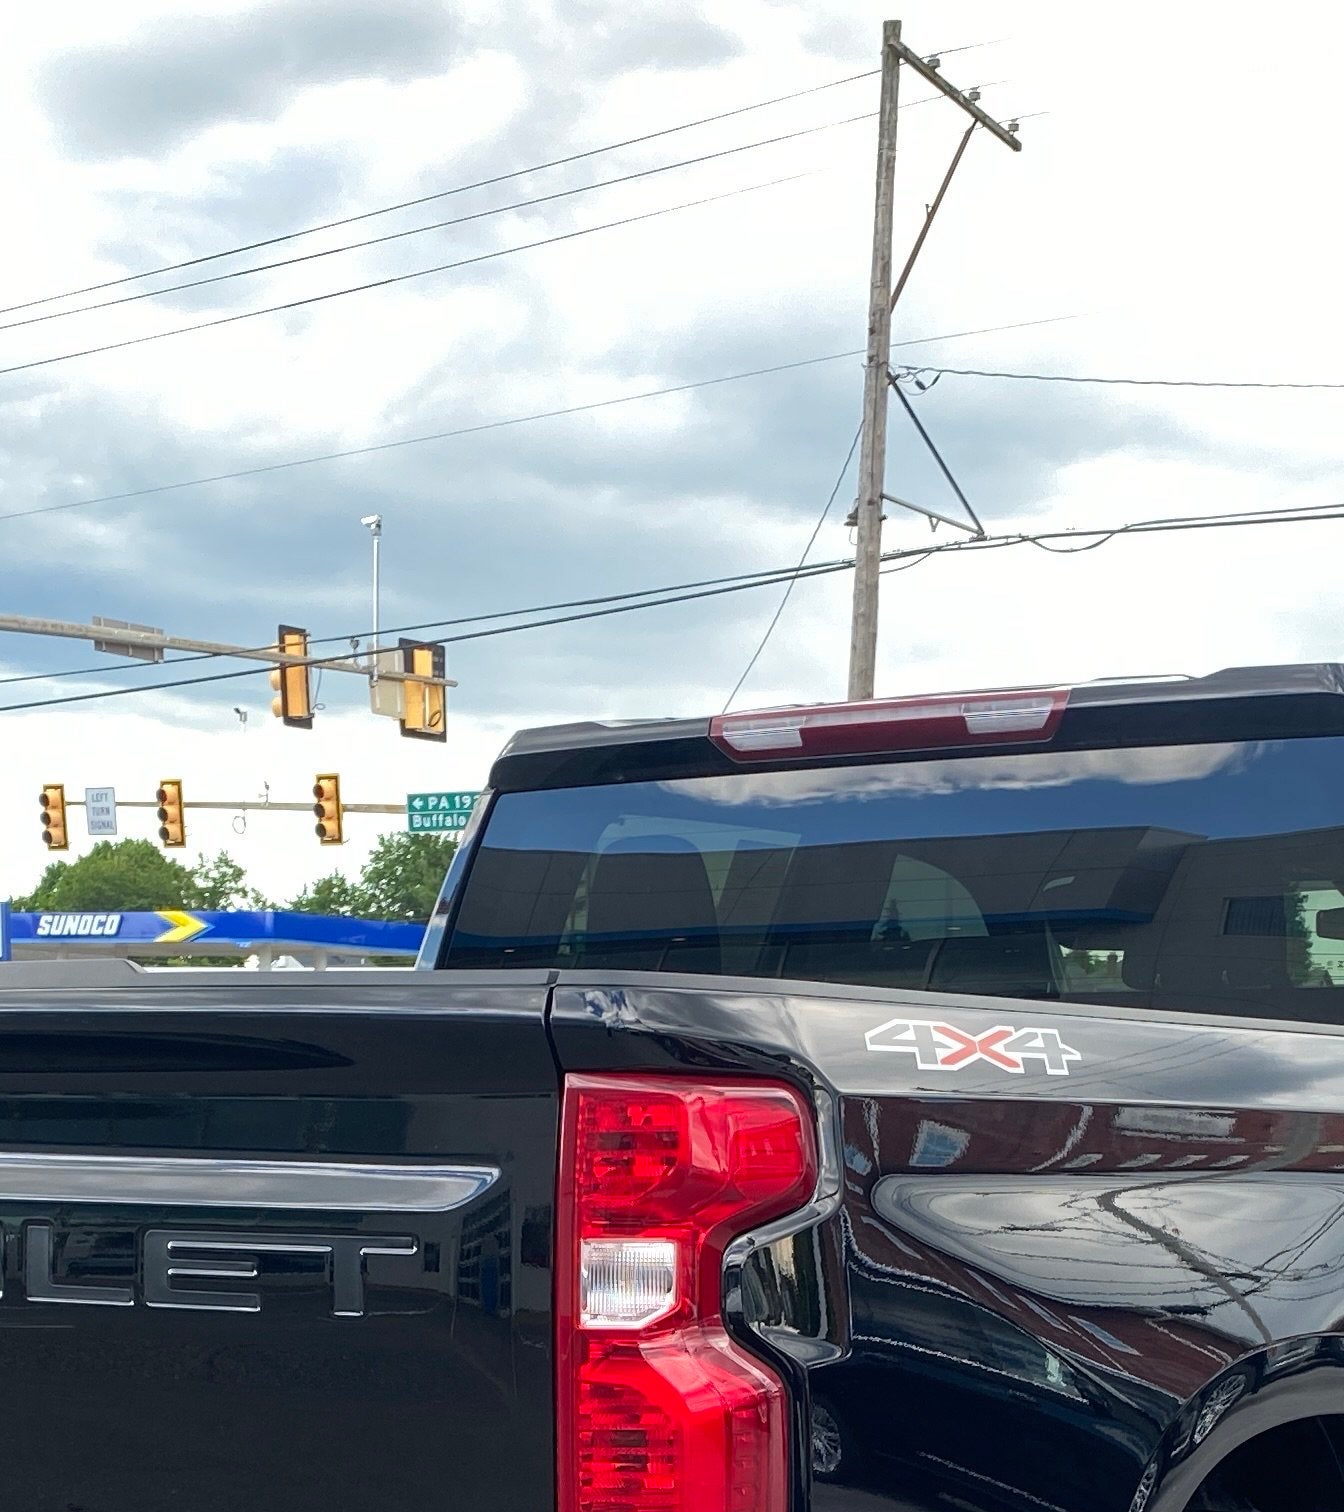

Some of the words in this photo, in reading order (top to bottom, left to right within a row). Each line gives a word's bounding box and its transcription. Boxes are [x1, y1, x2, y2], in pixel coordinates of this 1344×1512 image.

[91, 792, 108, 803] LEFT
[428, 796, 450, 810] PA
[92, 806, 110, 817] TURN
[412, 813, 467, 828] Buffalo
[36, 914, 123, 936] SUNOCO
